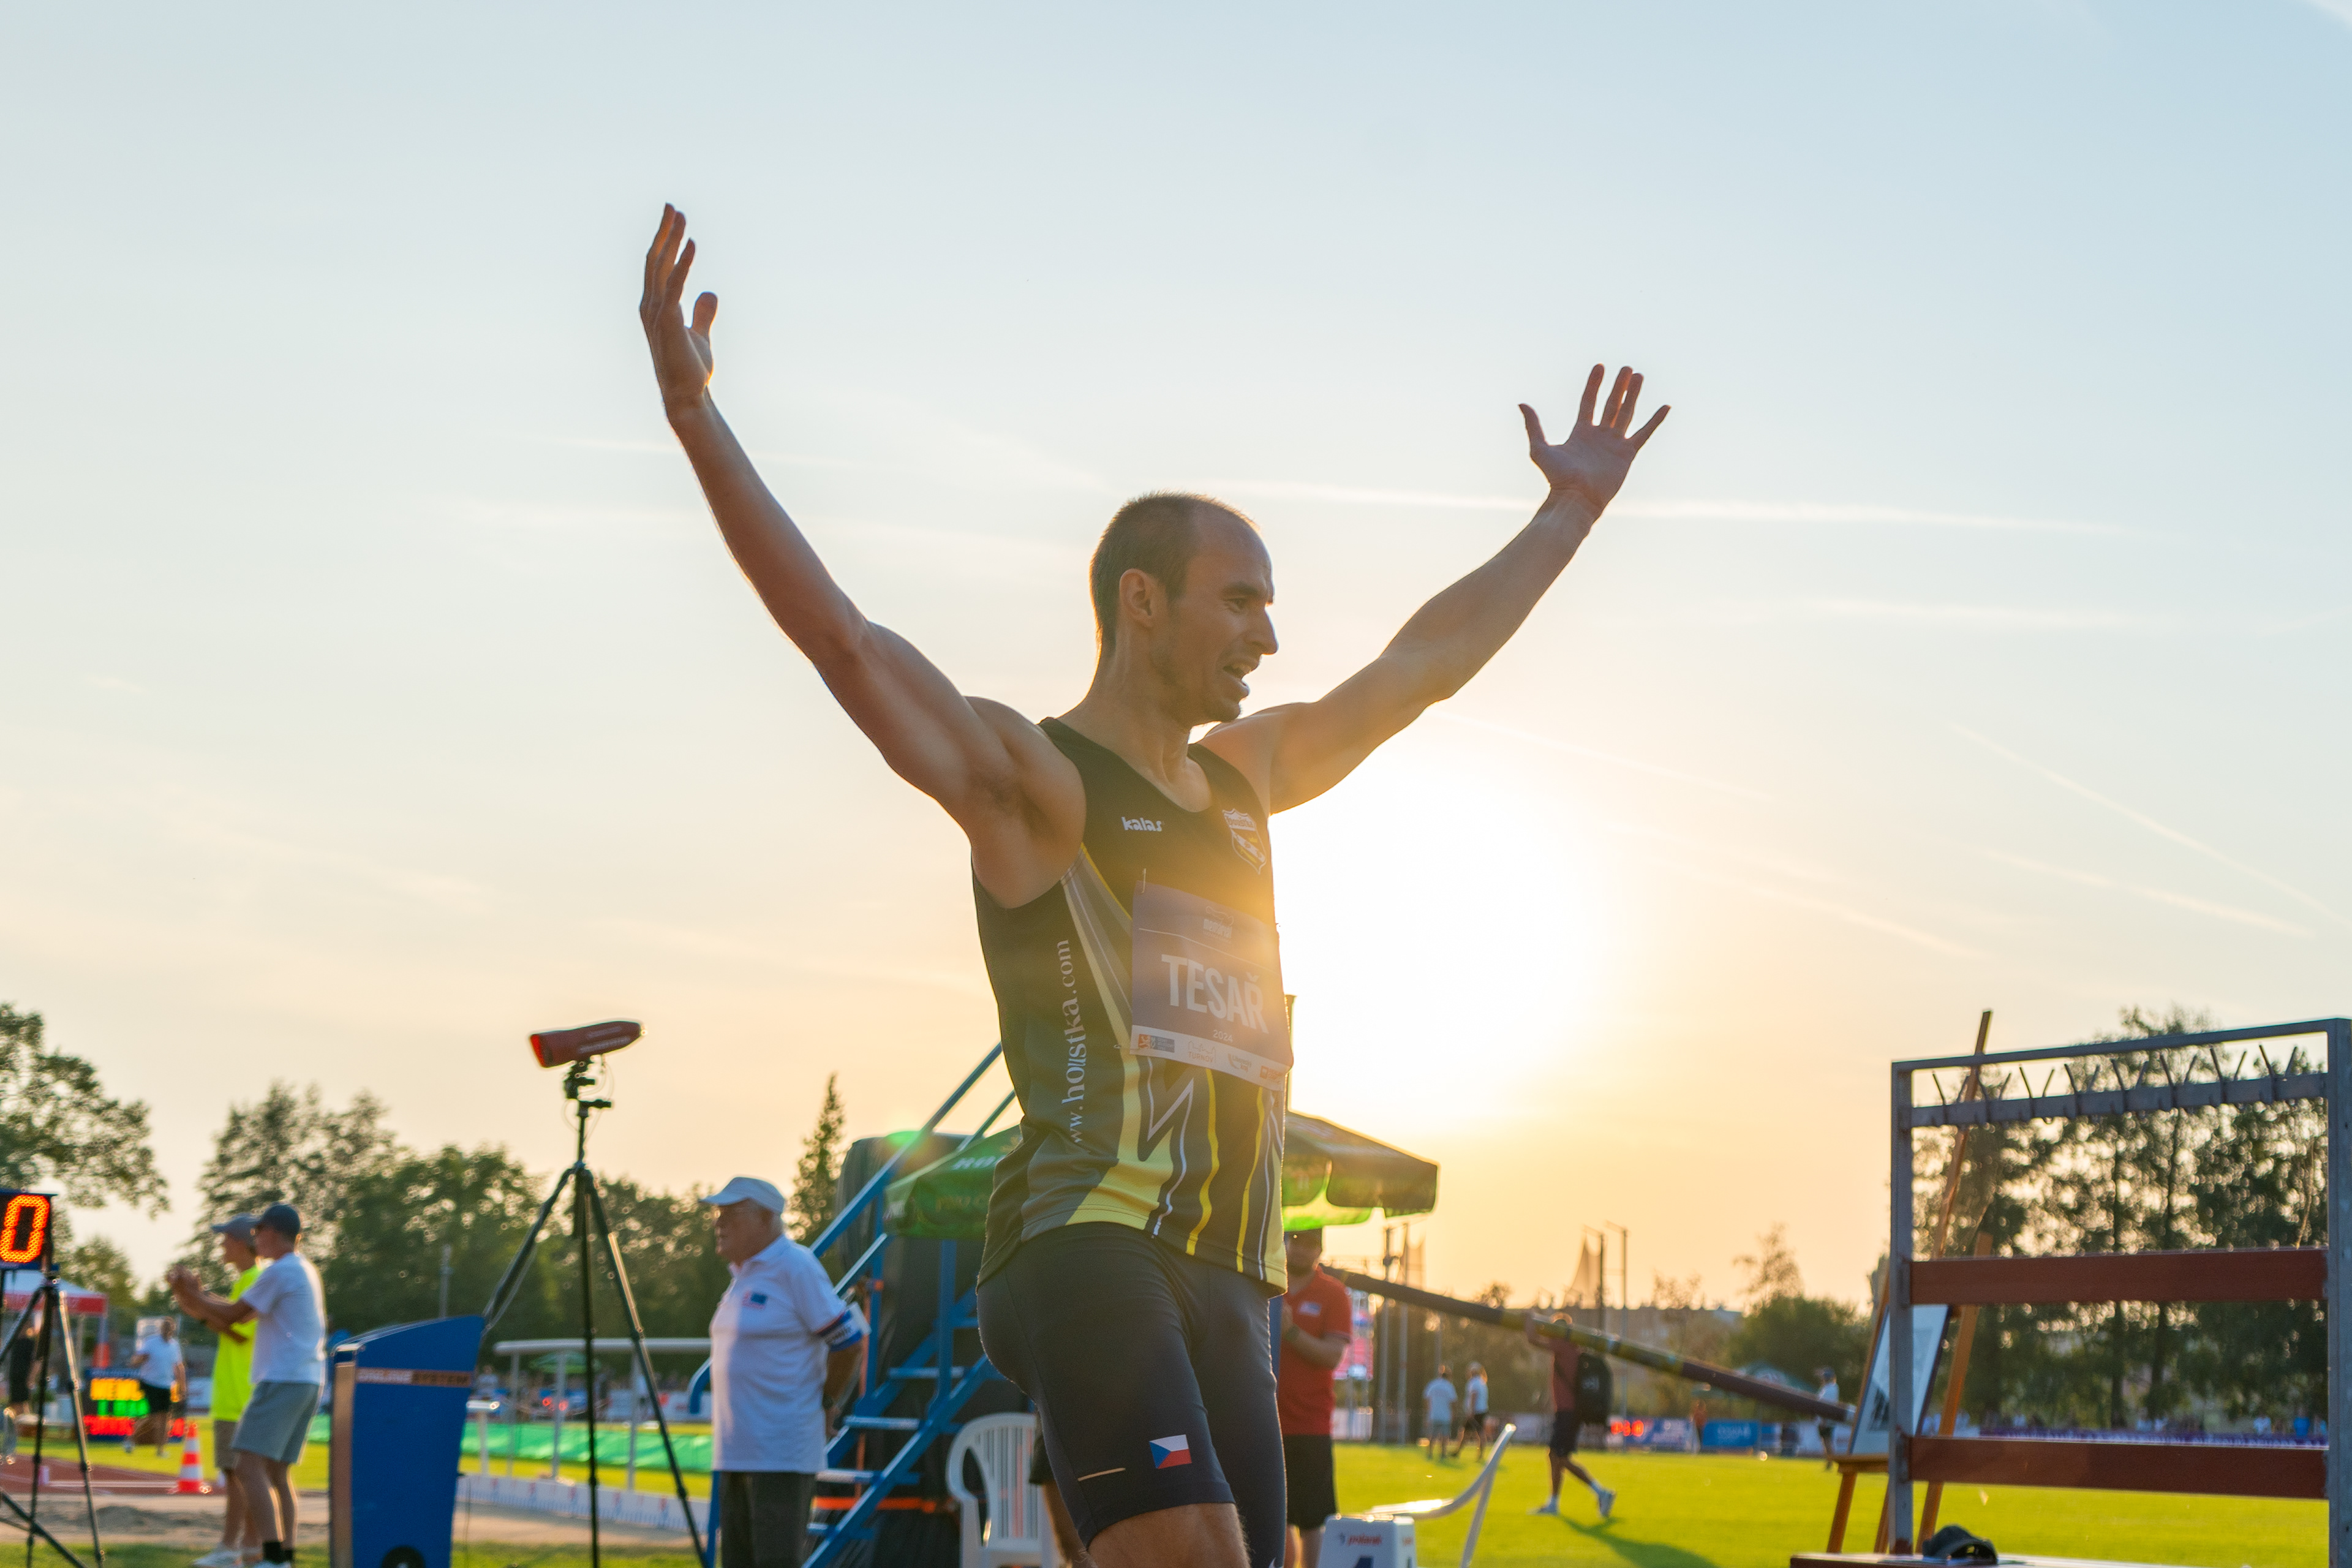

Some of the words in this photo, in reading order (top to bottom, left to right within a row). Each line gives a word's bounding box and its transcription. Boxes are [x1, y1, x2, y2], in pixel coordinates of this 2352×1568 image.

[1121, 816, 1163, 832] kalas
[1161, 954, 1269, 1034] TESAŘ
[1213, 1029, 1234, 1043] 2024
[1188, 1050, 1214, 1063] TURNOV
[0, 1194, 50, 1263] 0
